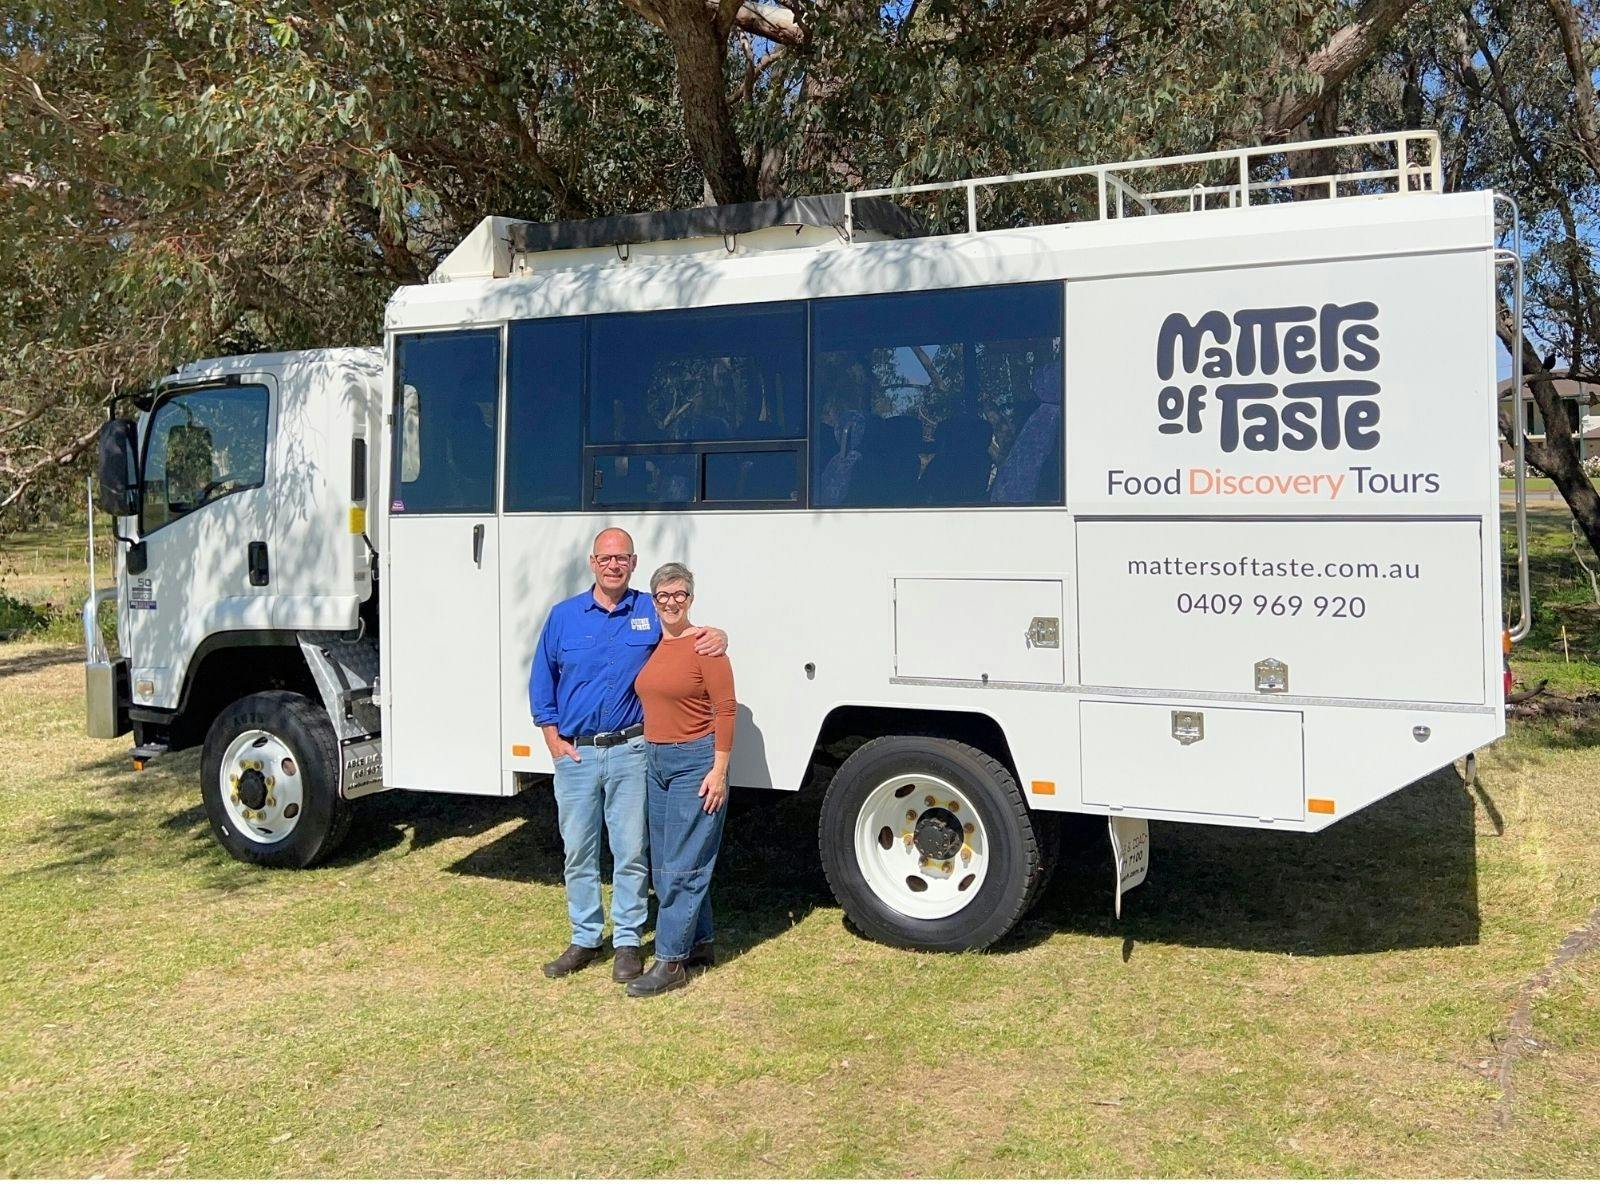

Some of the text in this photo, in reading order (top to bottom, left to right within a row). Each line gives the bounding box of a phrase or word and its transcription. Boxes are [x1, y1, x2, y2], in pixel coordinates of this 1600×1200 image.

[1156, 301, 1380, 381] Matters
[1215, 379, 1381, 453] Taste
[1108, 466, 1440, 500] Food Discovery Tours
[1128, 557, 1420, 579] mattersoftaste.com.au
[1177, 593, 1366, 618] 0409 969 920
